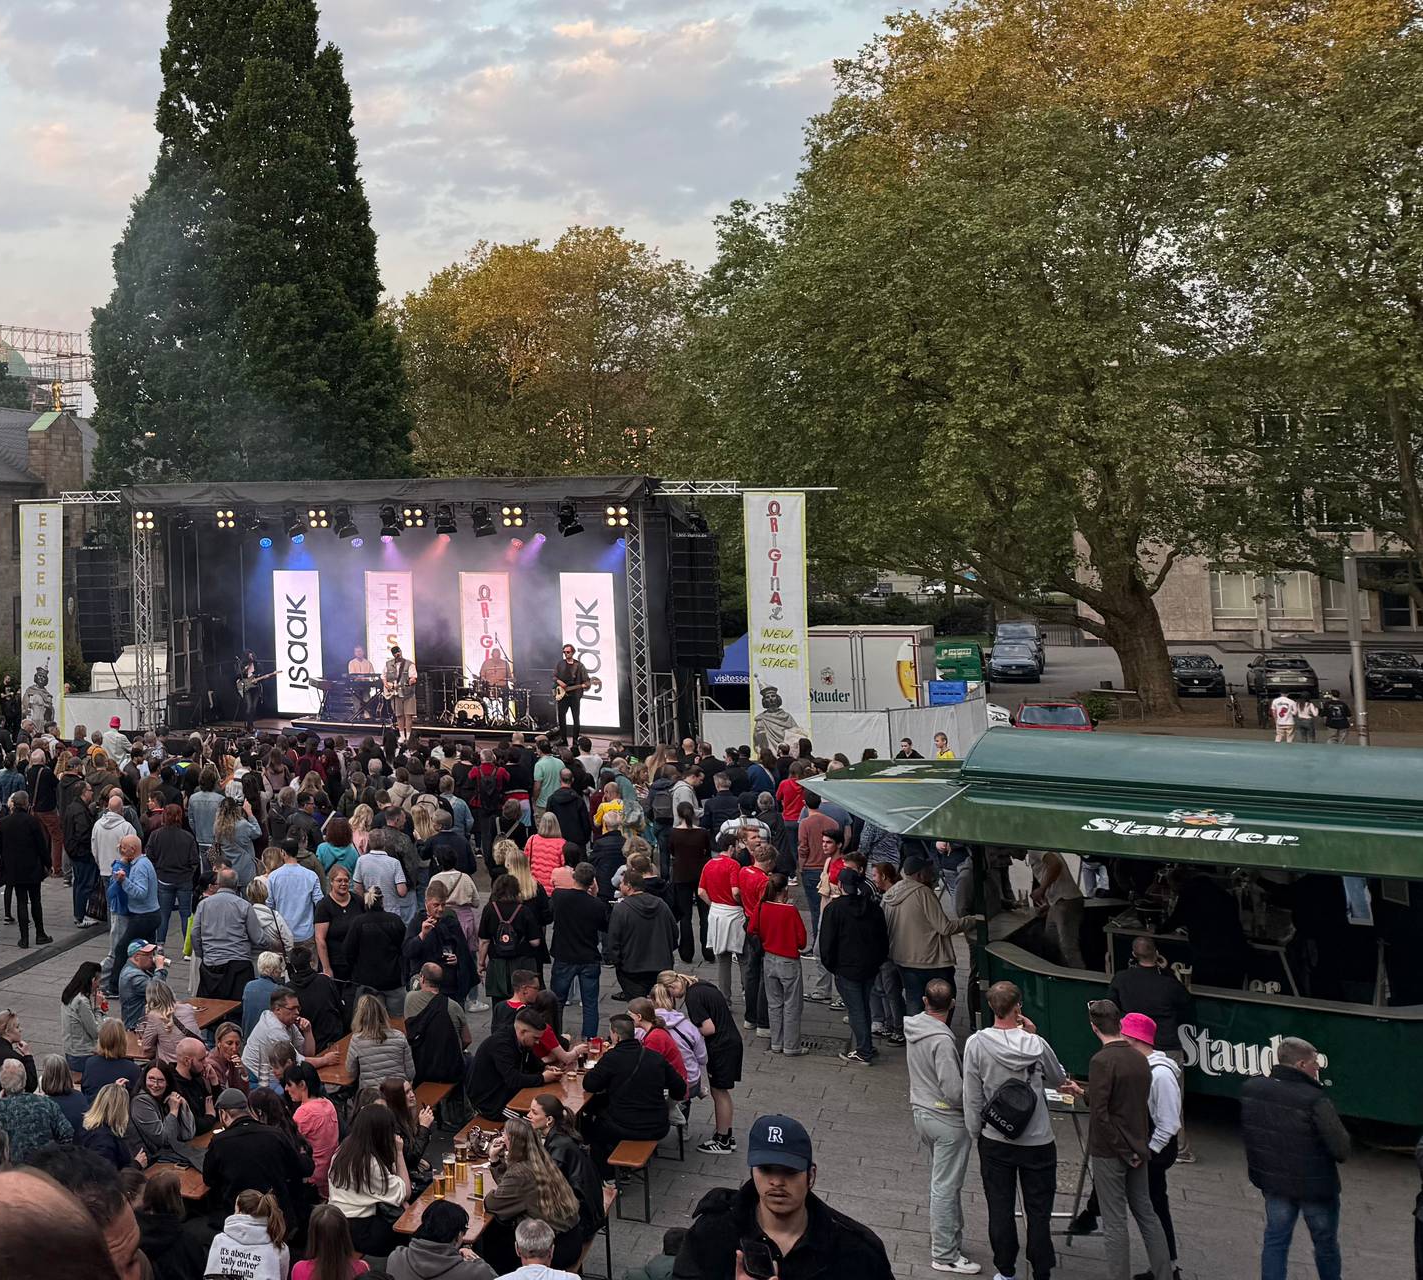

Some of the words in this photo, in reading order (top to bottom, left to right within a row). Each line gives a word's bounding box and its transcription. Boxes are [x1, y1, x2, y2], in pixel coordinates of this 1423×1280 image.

[35, 513, 47, 607] ESSEN
[30, 617, 52, 626] NEW
[27, 630, 55, 640] MUSIC
[763, 628, 794, 639] NEW
[28, 642, 53, 651] STAGE
[759, 643, 798, 654] MUSIC
[760, 658, 796, 669] STAGE
[714, 674, 750, 684] visitesse
[1081, 817, 1300, 846] Stauder
[988, 1108, 1015, 1132] HUGO
[768, 1126, 784, 1144] R
[230, 1249, 251, 1260] about
[252, 1254, 262, 1262] as
